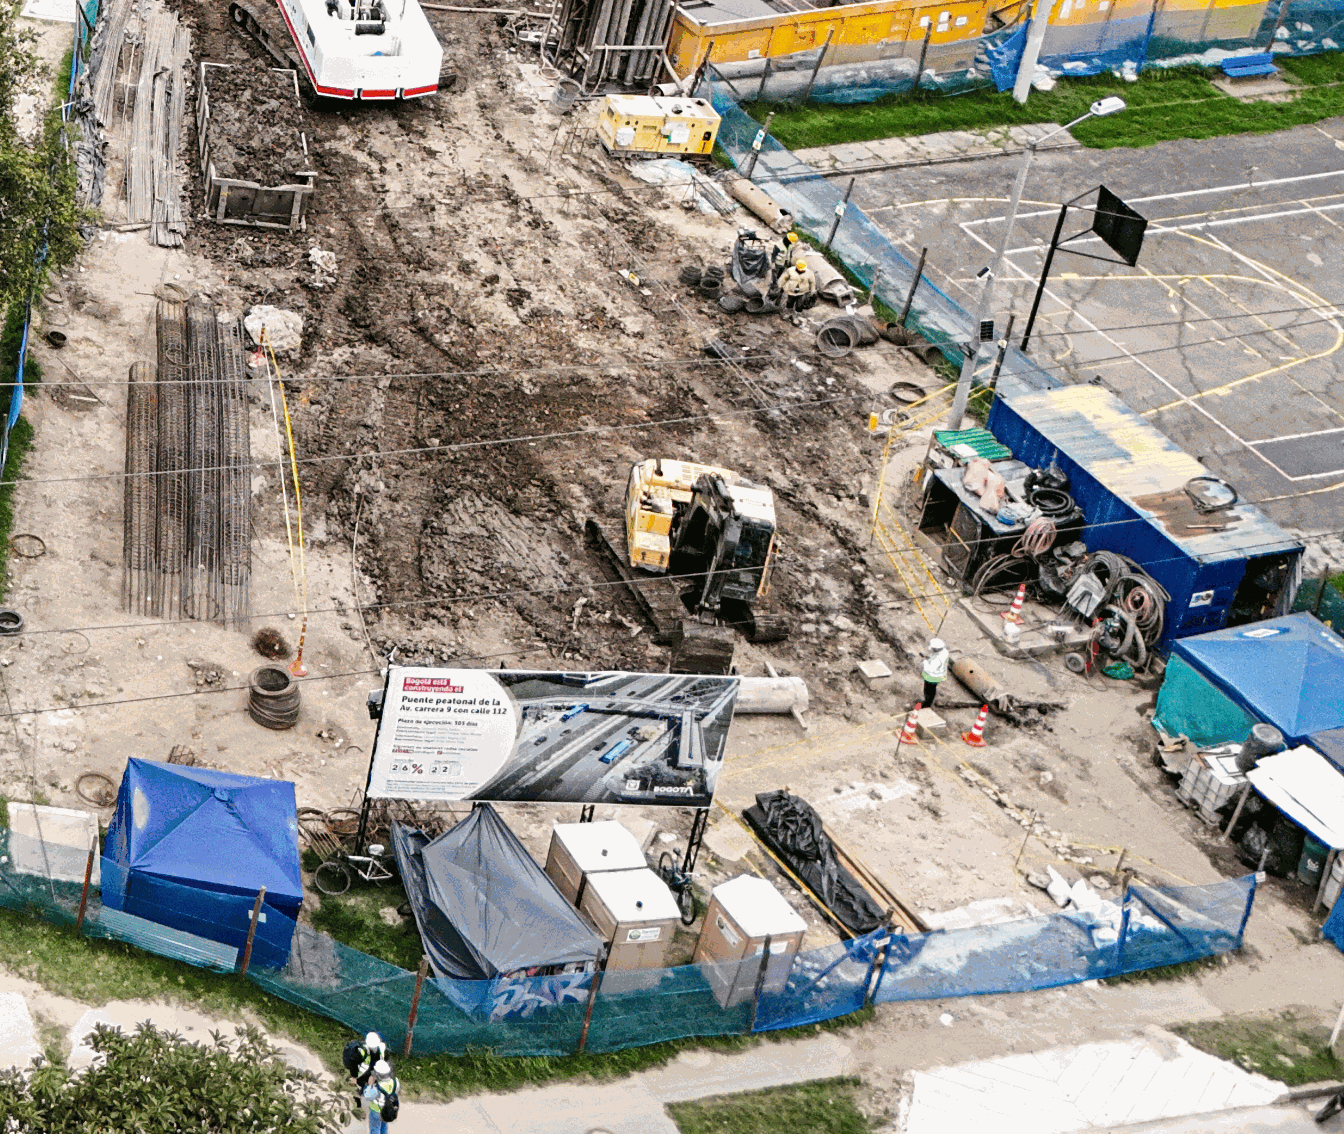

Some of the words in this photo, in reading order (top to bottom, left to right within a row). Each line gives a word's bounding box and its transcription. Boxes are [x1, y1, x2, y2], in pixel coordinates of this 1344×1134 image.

[401, 695, 434, 704] Puente
[435, 697, 477, 706] peatonal
[478, 698, 490, 706] de
[492, 698, 501, 706] la
[400, 704, 412, 712] Av.
[470, 707, 491, 715] calle
